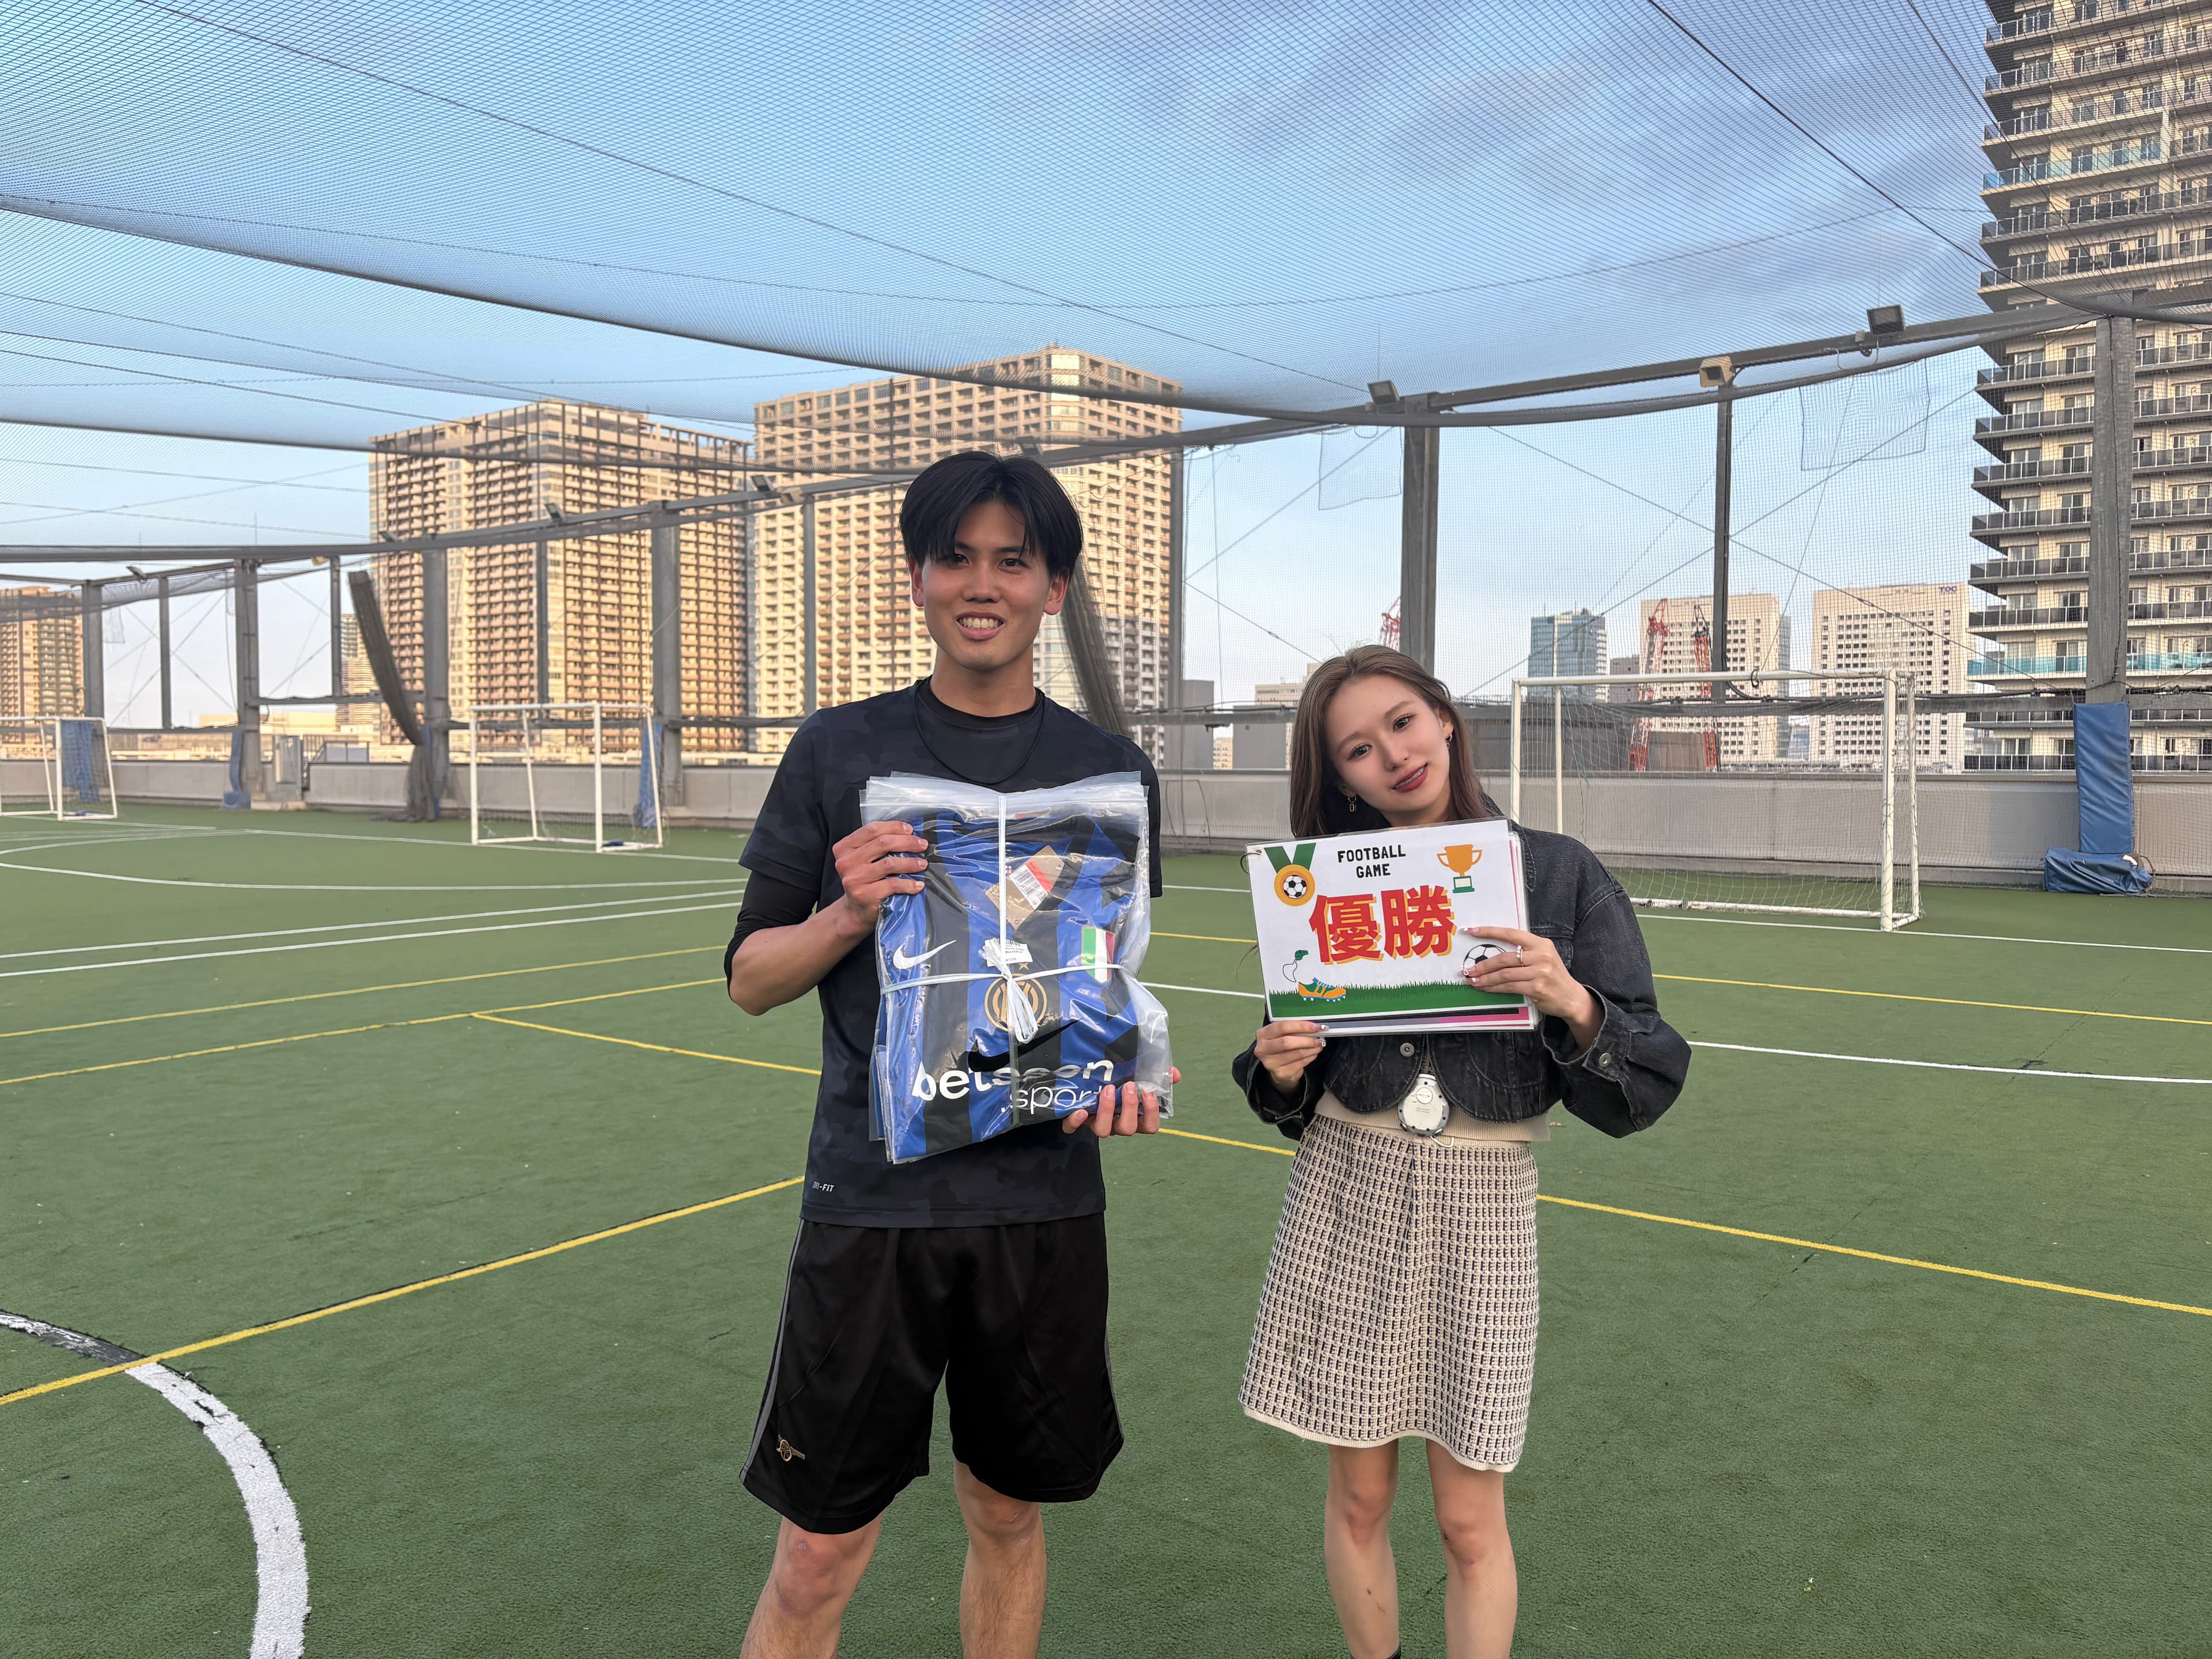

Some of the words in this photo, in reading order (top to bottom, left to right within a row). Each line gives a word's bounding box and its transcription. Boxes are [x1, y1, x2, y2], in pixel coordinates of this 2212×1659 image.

[1337, 844, 1406, 863] FOOTBALL
[1355, 863, 1391, 879] GAME
[1309, 885, 1456, 965] 優勝
